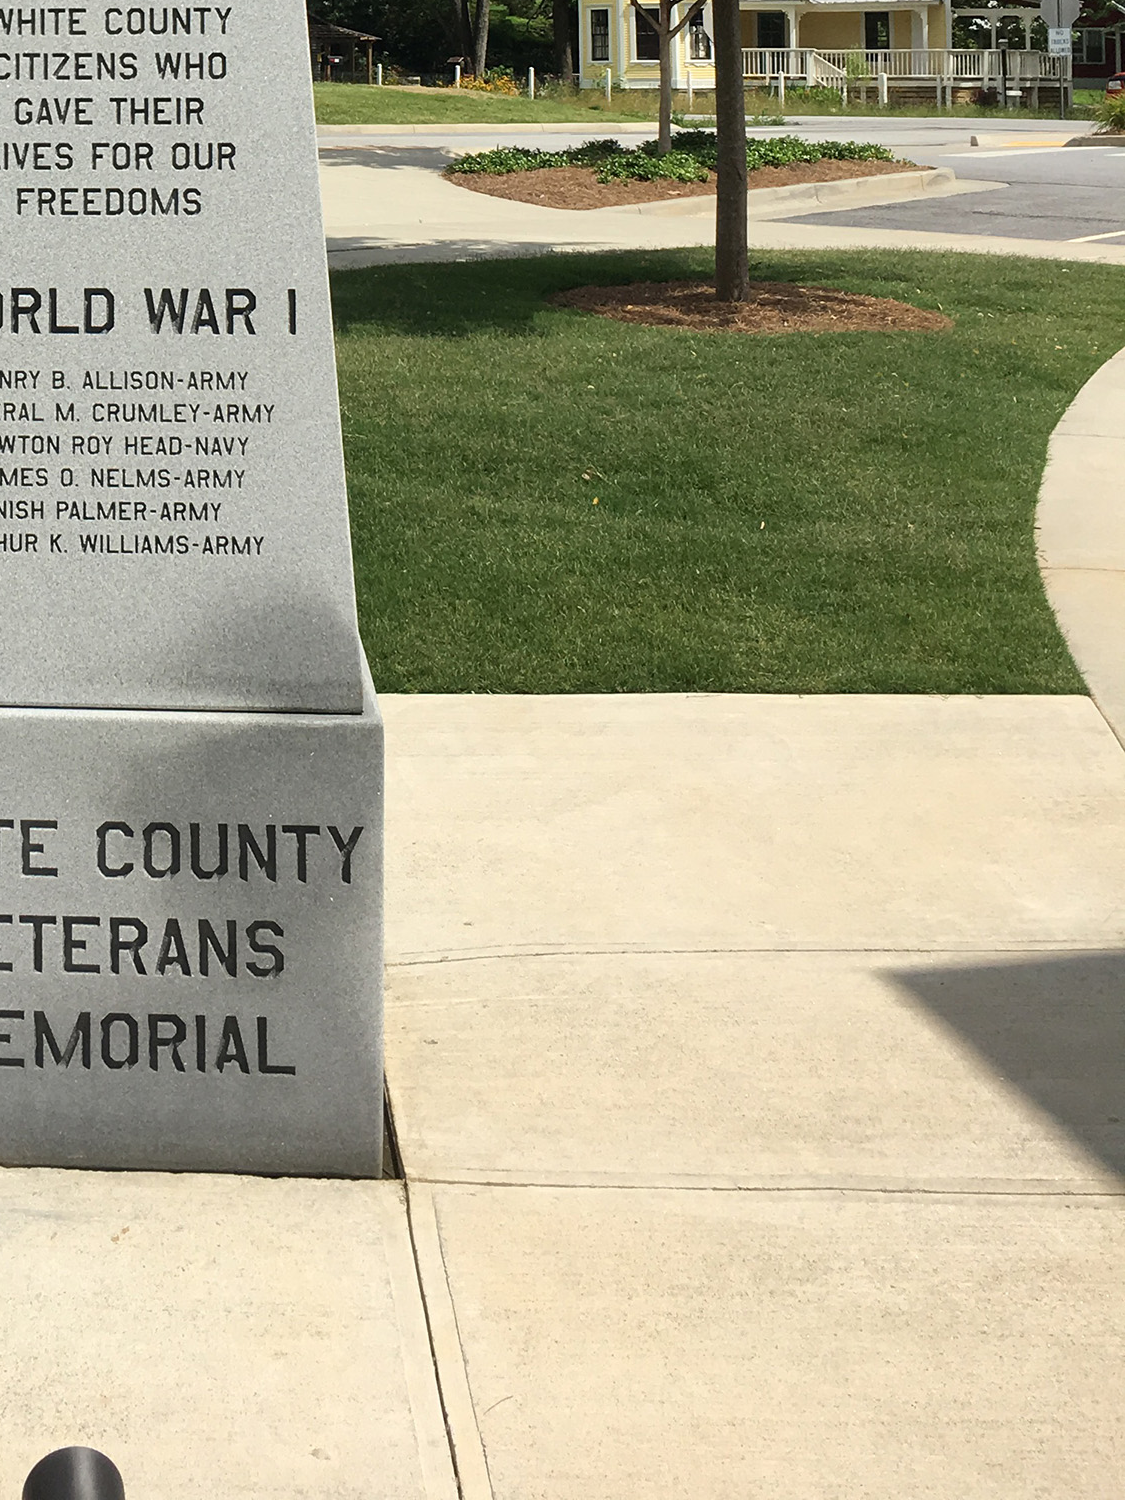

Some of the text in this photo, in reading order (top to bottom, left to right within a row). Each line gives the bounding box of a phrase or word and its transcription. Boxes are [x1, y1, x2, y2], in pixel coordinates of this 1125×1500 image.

[105, 7, 232, 35] COUNTY
[155, 52, 227, 80] WHO
[14, 98, 204, 125] GAVE THEIR
[92, 143, 153, 170] FOR
[171, 143, 236, 170] OUR
[17, 188, 201, 215] FREEDOMS
[143, 288, 256, 335] WAR
[288, 289, 296, 335] I
[52, 371, 71, 390] B.
[82, 371, 248, 390] ALLISON-ARMY
[56, 403, 80, 422] M.
[93, 403, 274, 423] CRUMLEY-ARMY
[72, 436, 113, 455] ROY
[125, 436, 248, 456] HEAD-NAVY
[61, 468, 79, 487] O.
[91, 468, 245, 488] NELMS-ARMY
[57, 501, 221, 521] PALMER-ARMY
[50, 534, 68, 553] K.
[79, 534, 264, 555] WILLIAMS-ARMY
[96, 821, 364, 883] COUNTY
